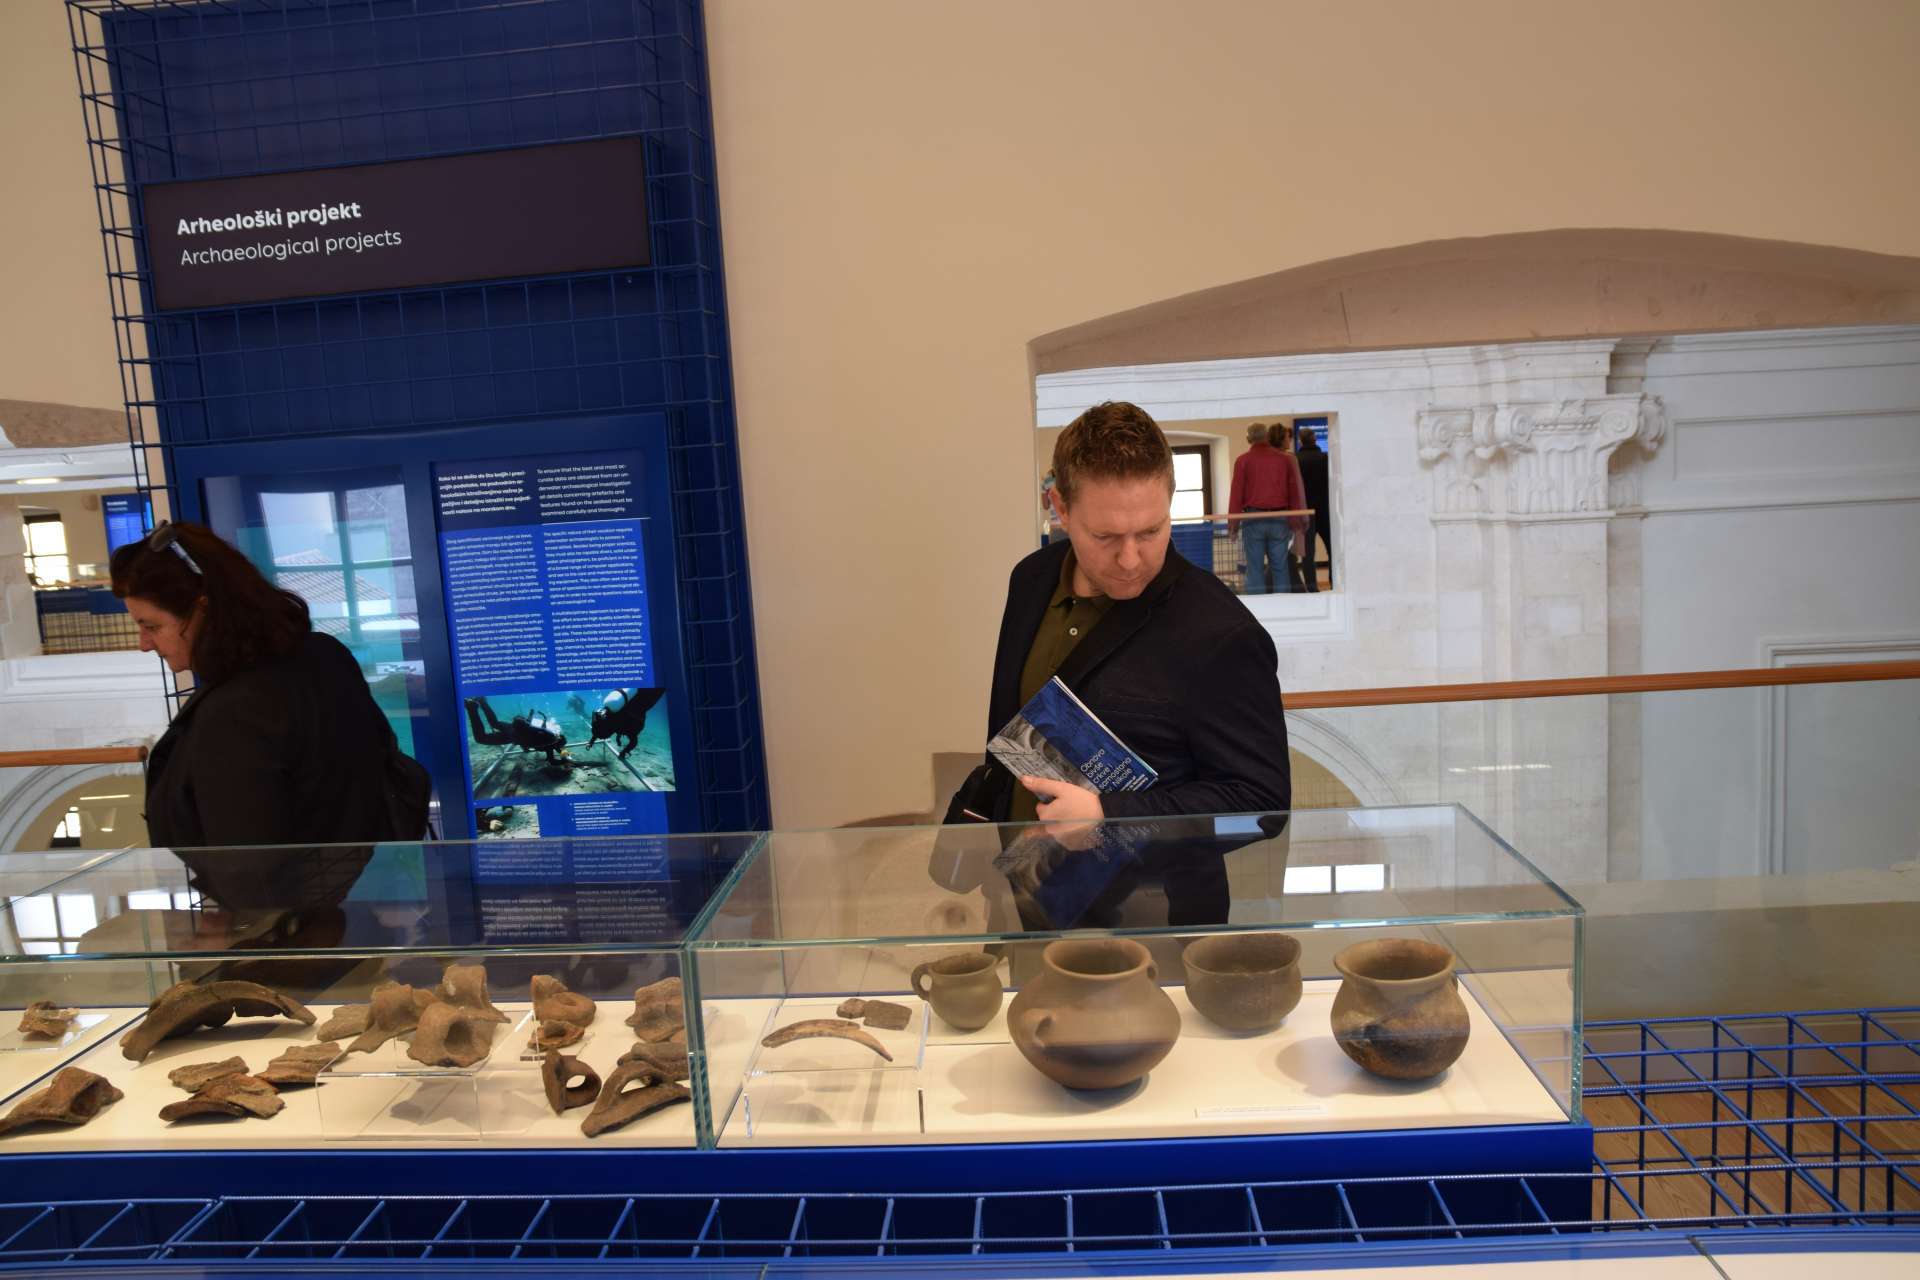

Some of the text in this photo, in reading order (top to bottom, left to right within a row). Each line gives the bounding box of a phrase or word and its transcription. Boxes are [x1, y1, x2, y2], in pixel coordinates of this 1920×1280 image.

[177, 202, 362, 235] Arheološki projekt
[181, 229, 402, 266] Archaeological projects
